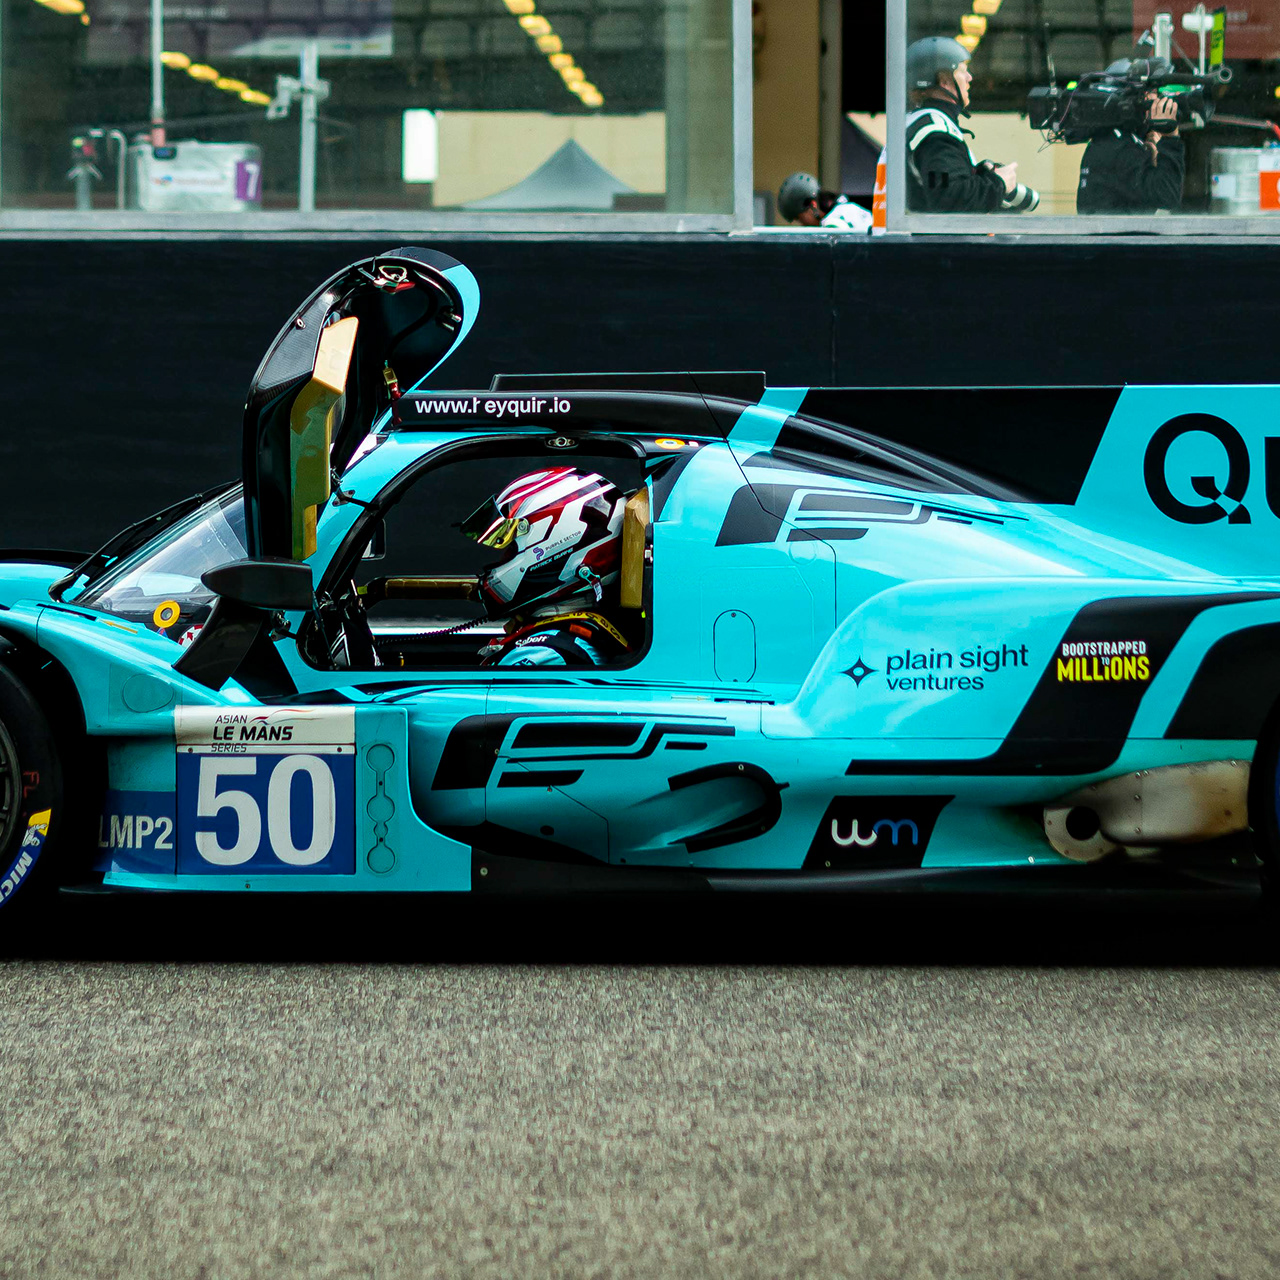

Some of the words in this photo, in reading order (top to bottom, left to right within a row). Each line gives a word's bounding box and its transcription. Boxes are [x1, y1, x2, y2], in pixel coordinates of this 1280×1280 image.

[244, 163, 260, 199] 7
[1062, 640, 1147, 657] BOOTSTRAPPED
[886, 647, 953, 675] plain
[959, 643, 1029, 673] sight
[886, 673, 984, 690] ventures
[215, 714, 248, 725] ASIAN
[212, 725, 236, 741] LE
[239, 725, 294, 741] MANS
[211, 742, 248, 754] SERIES
[194, 754, 337, 866] 50
[98, 814, 174, 850] LMP2
